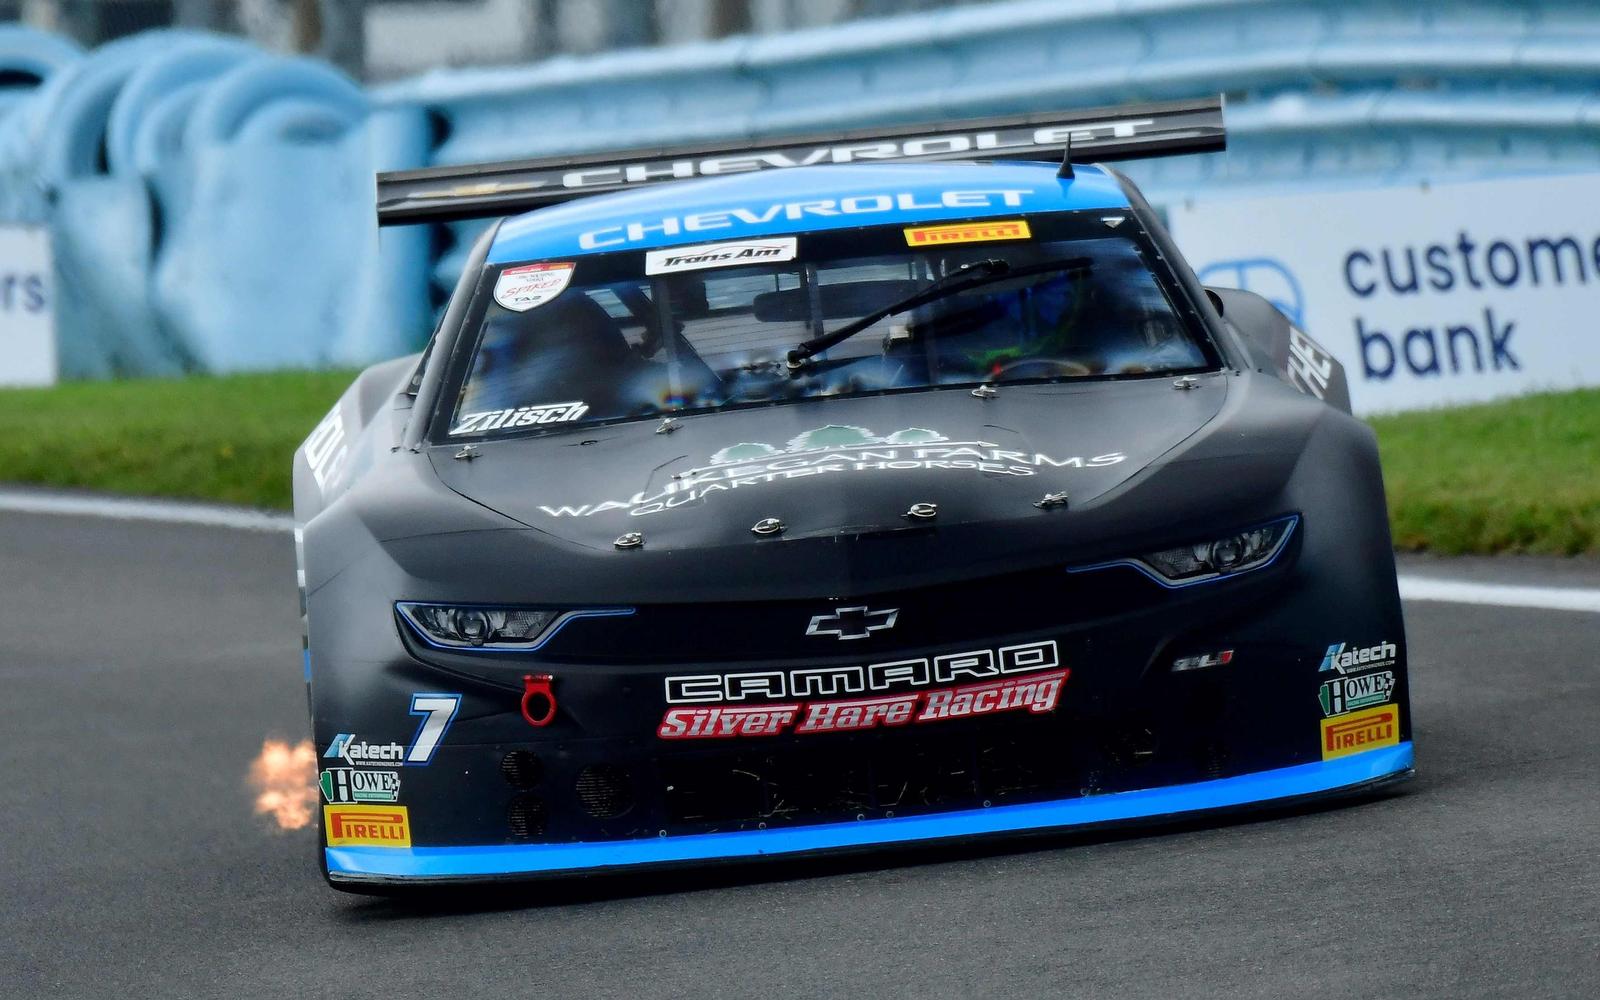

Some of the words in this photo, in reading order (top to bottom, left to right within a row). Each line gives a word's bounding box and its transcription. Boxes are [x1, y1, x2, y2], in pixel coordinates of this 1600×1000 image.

[562, 119, 1154, 190] CHEVROLET
[578, 189, 1034, 251] CHEVROLET
[912, 224, 1020, 242] PIRELLI
[663, 252, 732, 267] Trans
[733, 247, 782, 260] Am
[1342, 229, 1600, 298] custom
[1354, 305, 1523, 382] bank
[448, 401, 590, 435] Zilisch
[914, 446, 1128, 469] FARMS
[629, 464, 845, 517] QUARTER
[854, 460, 1037, 477] HORSES
[665, 640, 1060, 704] CAMARO
[1318, 641, 1397, 675] Katech
[660, 704, 799, 736] Silver
[800, 694, 918, 732] Hare
[918, 670, 1068, 720] Racing
[1328, 675, 1384, 717] HOWE
[323, 733, 404, 766] Katech
[404, 693, 462, 766] 7
[1325, 712, 1394, 752] PIRELLI
[330, 769, 392, 803] HOWE
[330, 812, 405, 840] PIRELLI
